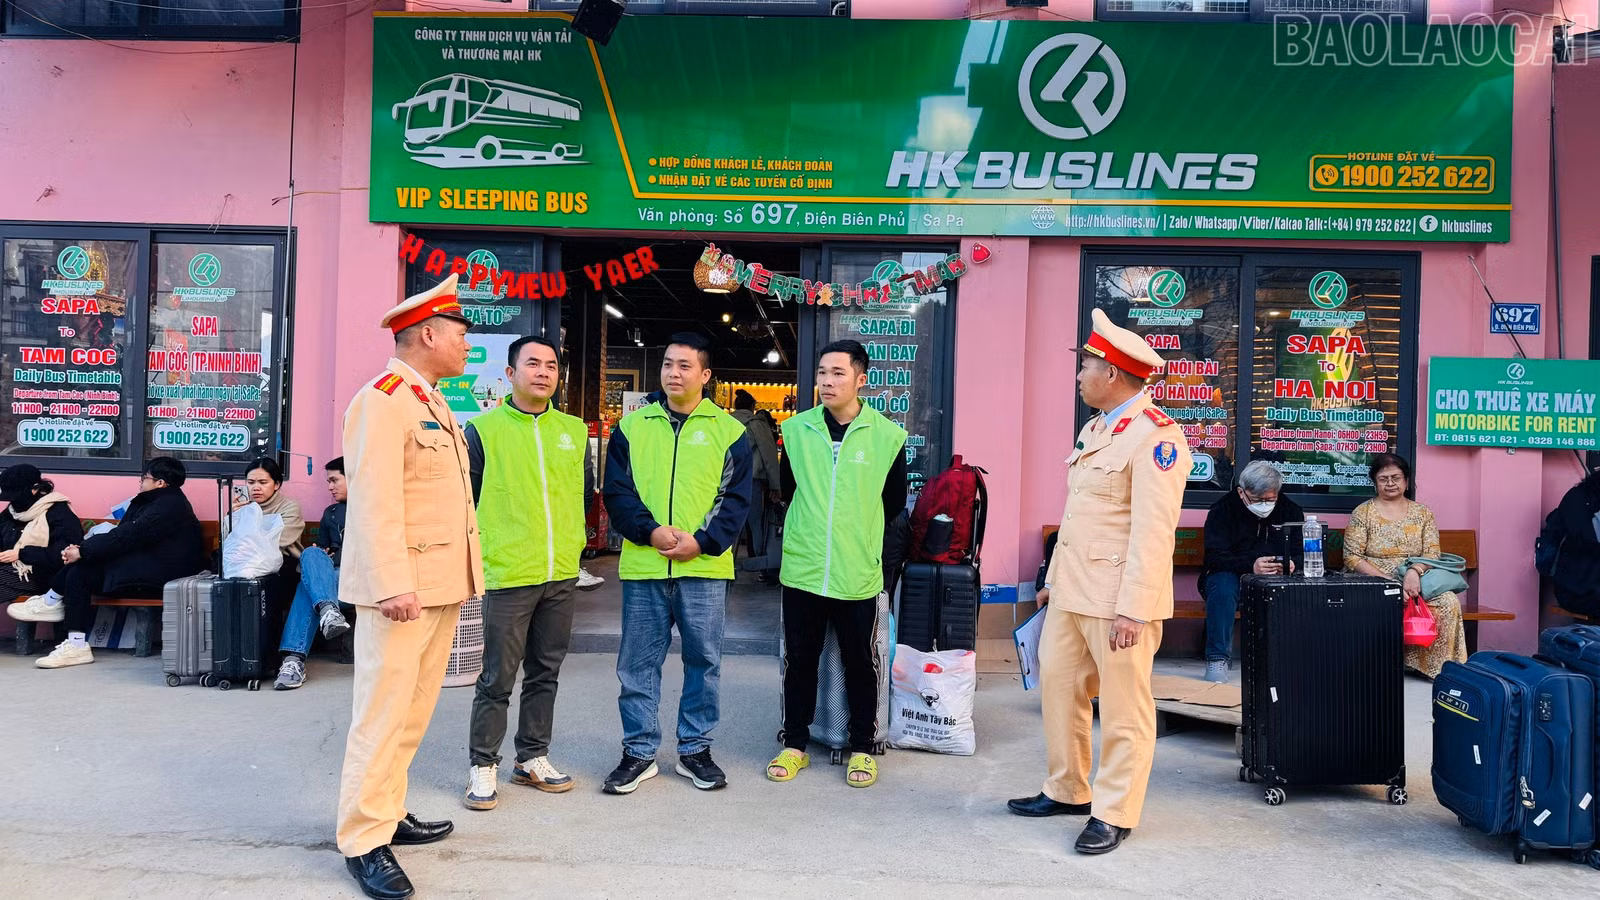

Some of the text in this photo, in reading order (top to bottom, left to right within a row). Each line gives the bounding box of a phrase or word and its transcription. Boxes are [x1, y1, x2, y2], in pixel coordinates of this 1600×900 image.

[415, 27, 572, 45] CÔNG TY TNHH DỊCH VỤ VẬN TẢI
[442, 45, 542, 63] VÀ THƯƠNG MẠI HK
[659, 156, 680, 170] HỢP
[683, 153, 711, 169] ĐỒNG
[714, 155, 748, 170] KHÁCH
[767, 156, 802, 171] KHÁCH
[805, 157, 833, 171] ĐOÀN
[1347, 151, 1435, 164] HOTLINE ĐẶT VÉ
[885, 150, 1259, 191] HK BUSLINES
[1340, 164, 1488, 188] 1900 252 622
[659, 172, 833, 191] NHẬN ĐẶT VÉ CÁC TUYẾN CỐ ĐỊNH
[396, 187, 588, 214] VIP SLEEPING BUS
[638, 203, 964, 229] Văn phòng: Số 697, Điện Biên Phủ Sa Pa
[1356, 218, 1373, 232] 979
[1375, 218, 1392, 232] 252
[1442, 219, 1492, 234] hkbuslines
[583, 245, 660, 291] YAER
[731, 259, 823, 305] MERRY
[41, 298, 100, 314] SAPA
[1495, 307, 1535, 322] 697
[485, 309, 502, 325] TO
[58, 327, 75, 337] To
[192, 317, 218, 336] SAPA
[860, 319, 915, 335] SAPA ĐI
[1145, 335, 1180, 349] SAPA
[1287, 334, 1366, 354] SAPA
[21, 347, 117, 365] TAM COC
[169, 345, 188, 371] CỐC
[192, 352, 232, 373] (TP.NINH
[234, 348, 262, 375] BÌNH)
[890, 345, 917, 361] BAY
[1169, 358, 1219, 377] NỘI BÀI
[1318, 360, 1336, 372] To
[14, 369, 121, 385] Daily Bus Timetable
[886, 367, 911, 386] BÀI
[14, 389, 42, 399] Departure
[58, 390, 71, 399] Tam
[1167, 383, 1212, 403] HÀ NỘI
[1275, 379, 1376, 400] HA NOI
[889, 391, 910, 413] CỔ
[1435, 387, 1596, 413] CHO THUÊ XE MÁY
[12, 403, 119, 415] 11H00 21H00 22H00
[148, 406, 255, 419] 11H00 21H00 22H00
[1267, 408, 1384, 422] Daily Bus Timetable
[1206, 426, 1227, 436] 13H00
[1435, 413, 1596, 433] MOTORBIKE FOR RENT
[24, 428, 108, 443] 1900 252 622
[159, 431, 244, 446] 1900 252 622
[1261, 428, 1388, 440] Departure from Hanoi: 06H00 23H59
[1452, 434, 1476, 443] 0815
[1479, 435, 1496, 443] 621
[1500, 435, 1517, 444] 621
[1528, 437, 1553, 445] 0328
[1557, 437, 1574, 446] 146
[1205, 439, 1227, 448] 23H00
[1262, 441, 1387, 453] Departure from Sapa: 07H30 23H00
[902, 708, 914, 721] Việt
[916, 711, 928, 722] Anh
[930, 715, 942, 726] Tây
